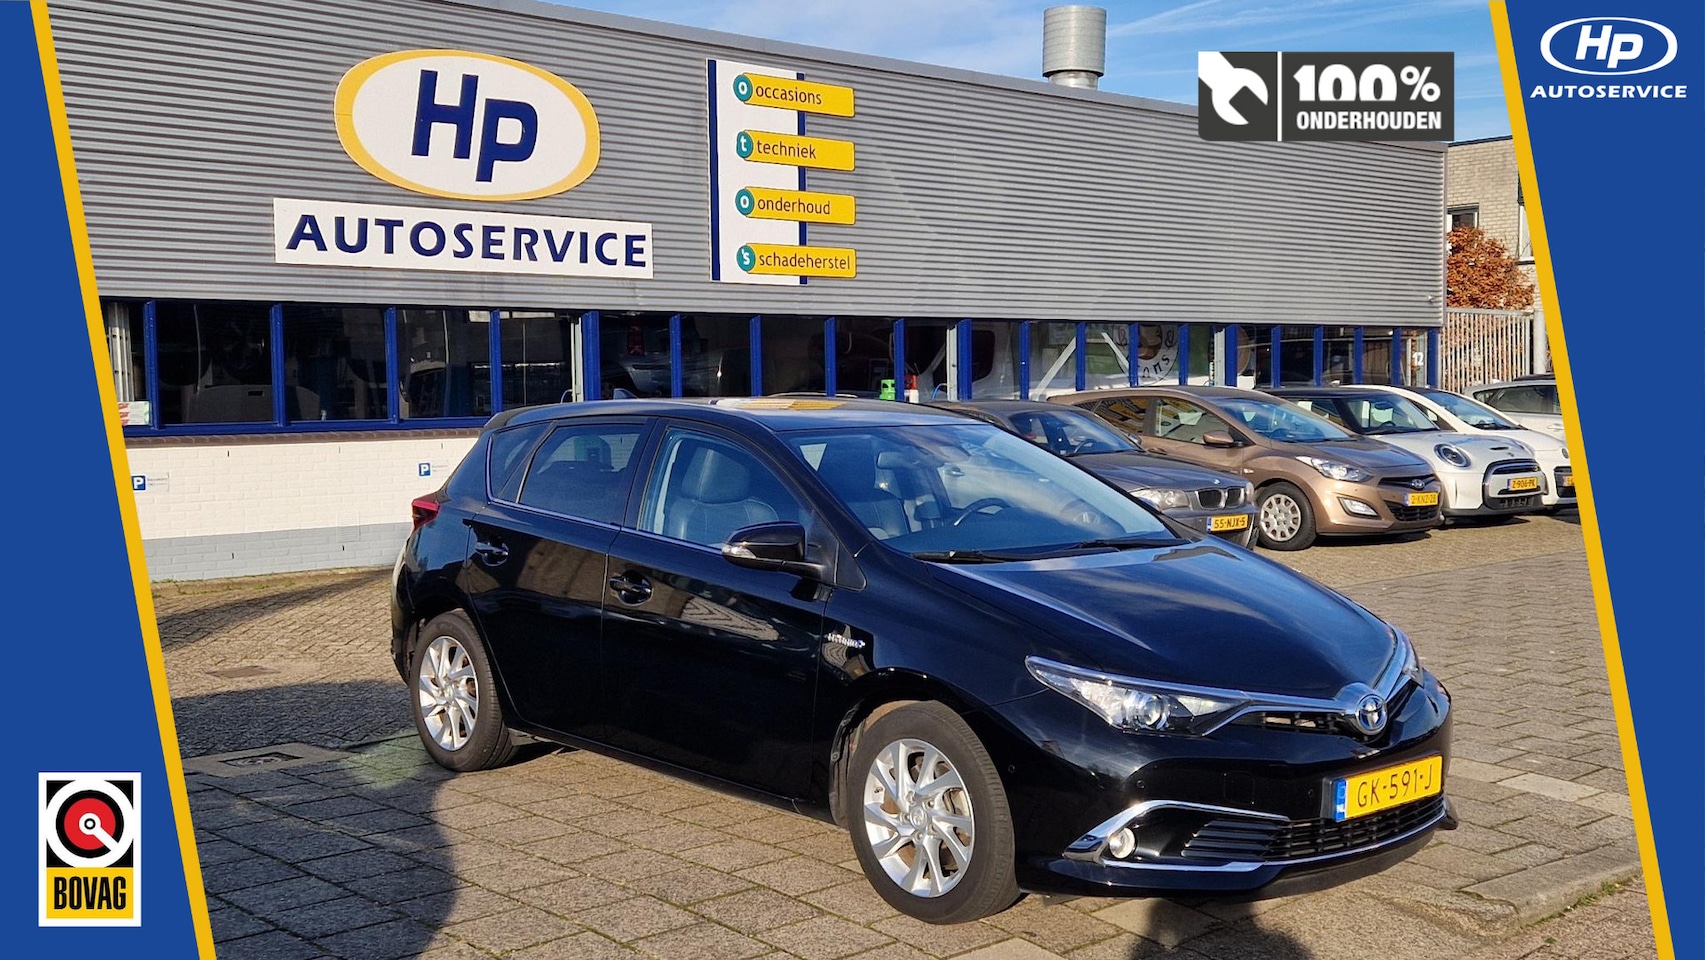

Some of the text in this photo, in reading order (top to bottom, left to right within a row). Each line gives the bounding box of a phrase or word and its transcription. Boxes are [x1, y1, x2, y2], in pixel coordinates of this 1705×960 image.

[755, 85, 822, 105] occasions
[756, 139, 817, 160] techniek
[757, 196, 831, 215] onderhoud
[286, 214, 647, 268] AUTOSERVICE
[759, 251, 851, 270] schadeherstel
[420, 464, 430, 475] P
[133, 477, 144, 490] P
[1357, 764, 1433, 808] GK-591-J
